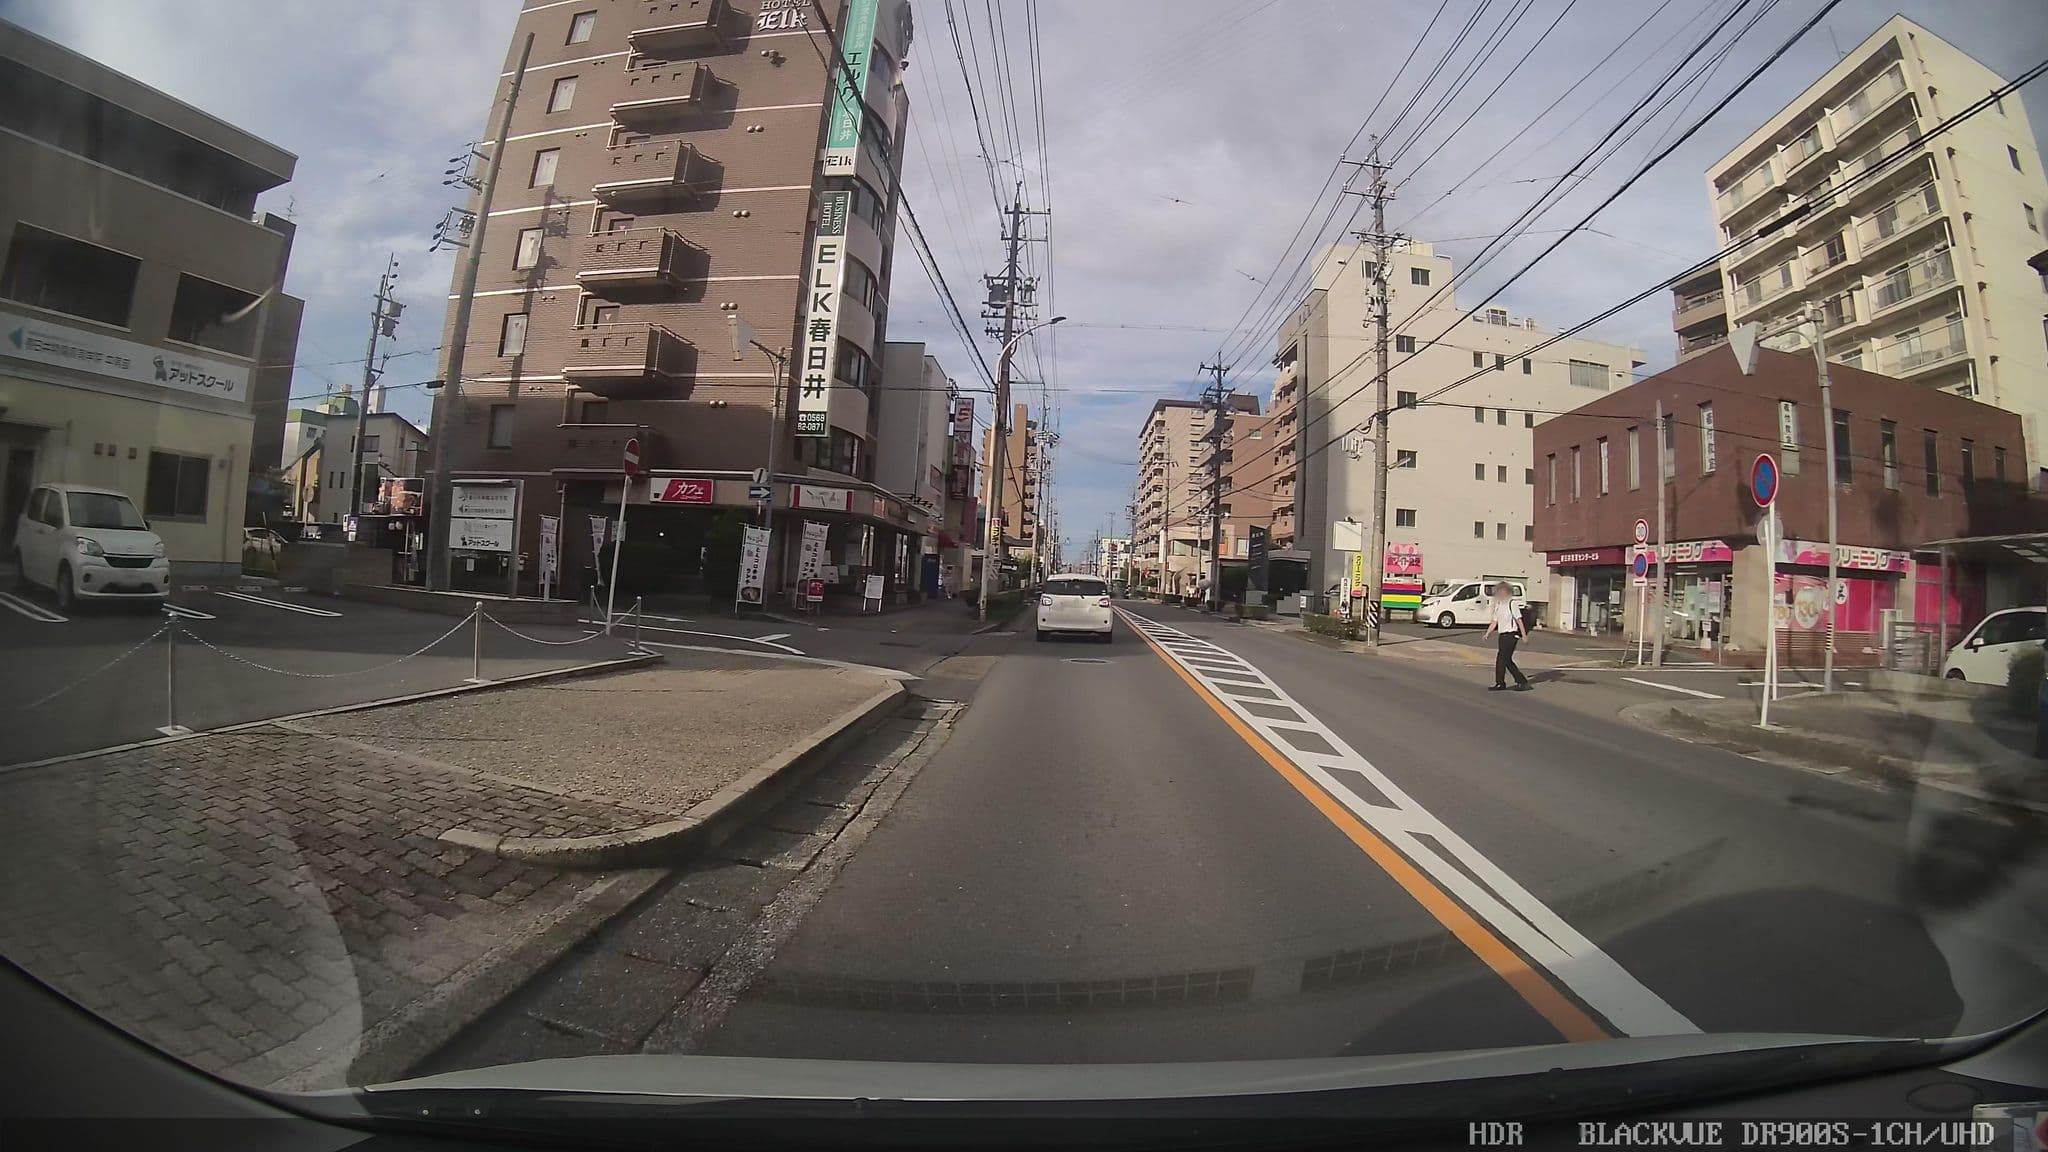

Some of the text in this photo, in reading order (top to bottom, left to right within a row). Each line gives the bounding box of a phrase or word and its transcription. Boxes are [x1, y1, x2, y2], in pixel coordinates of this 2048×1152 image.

[760, 0, 812, 10] HOTEL
[822, 202, 833, 229] HOTEL
[832, 196, 845, 235] BUSINESS
[168, 367, 234, 392] アットスクール
[671, 481, 705, 498] カフェ
